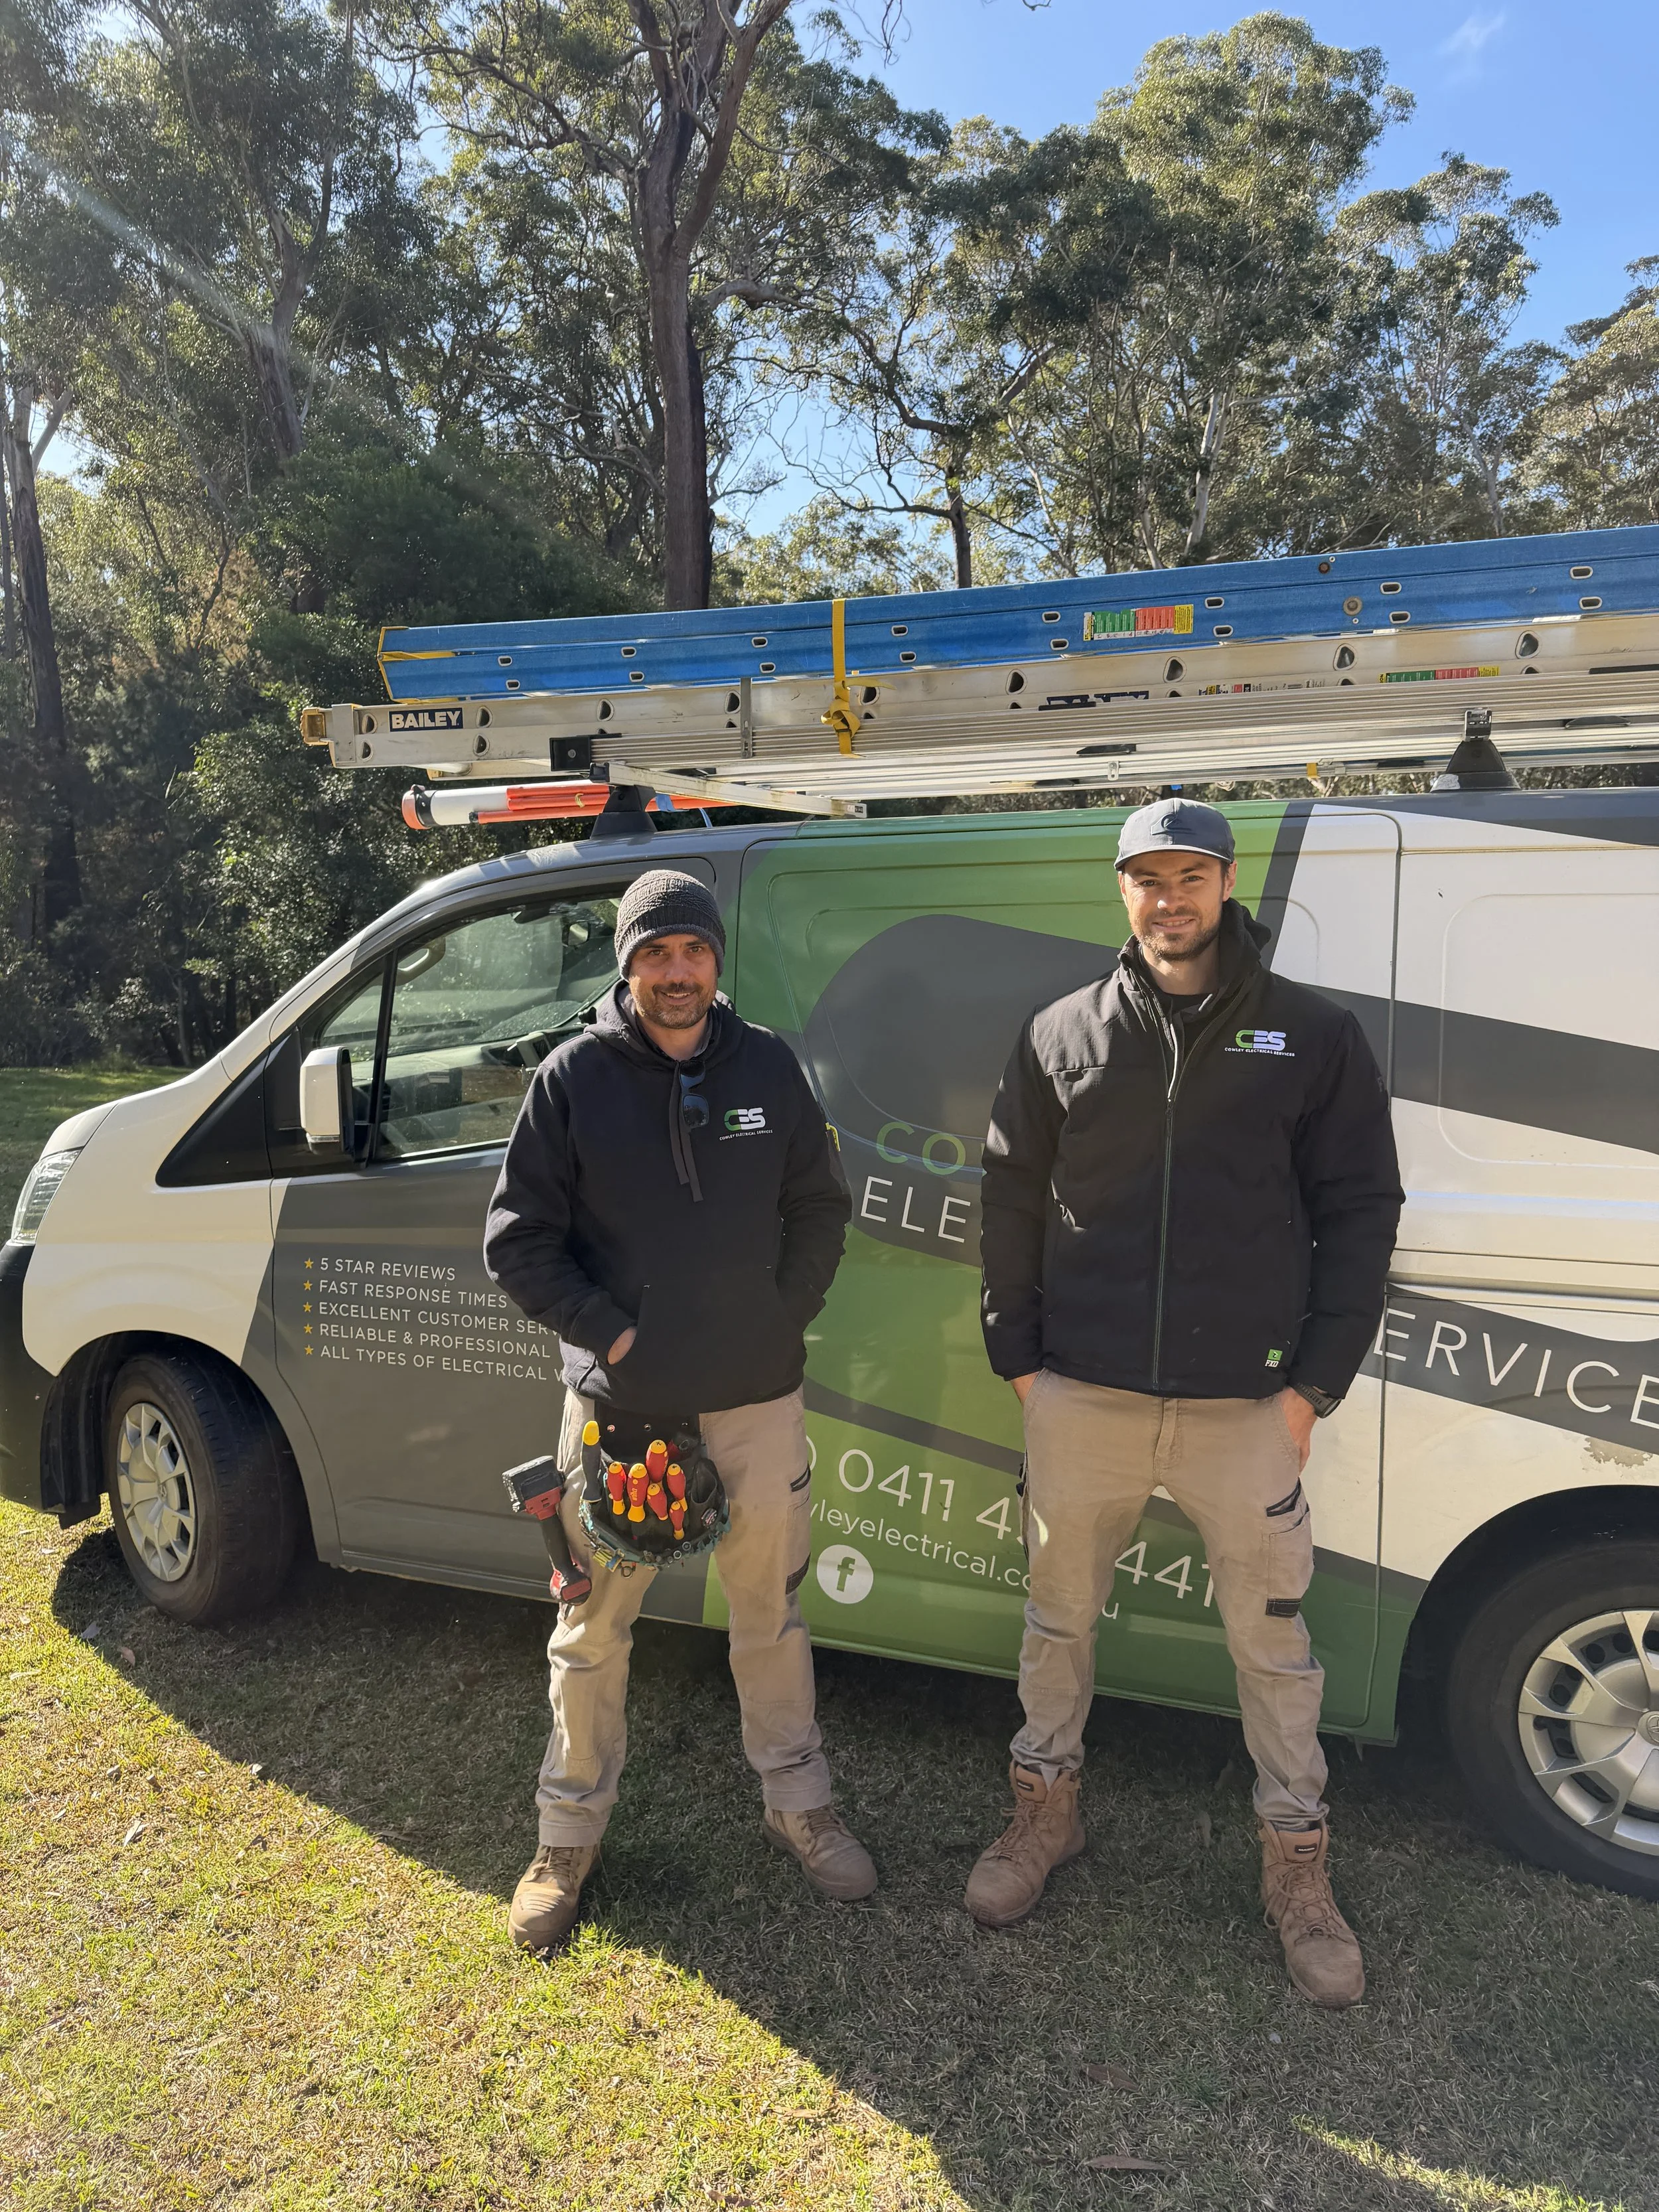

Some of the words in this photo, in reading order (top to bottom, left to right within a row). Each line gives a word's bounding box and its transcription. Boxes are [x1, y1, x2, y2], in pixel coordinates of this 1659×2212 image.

[391, 711, 461, 729] BAILEY
[877, 1122, 966, 1175] CO
[861, 1175, 971, 1243] ELE
[320, 1257, 328, 1271] 5
[334, 1258, 375, 1275] STAR
[382, 1262, 455, 1281] REVIEWS
[319, 1280, 358, 1295] FAST
[364, 1283, 451, 1303] RESPONSE
[458, 1291, 507, 1308] TIMES
[319, 1301, 411, 1322] EXCELLENT
[418, 1311, 509, 1331] CUSTOMER
[320, 1323, 397, 1343] RELIABLE
[403, 1331, 413, 1345] &
[419, 1333, 551, 1358] PROFESSIONAL
[321, 1345, 350, 1360] ALL
[356, 1348, 406, 1366] TYPES
[413, 1355, 435, 1368] OF
[442, 1357, 547, 1380] ELECTRICAL
[839, 1449, 955, 1522] 0411
[810, 1499, 1031, 1590] leyelectrical.c
